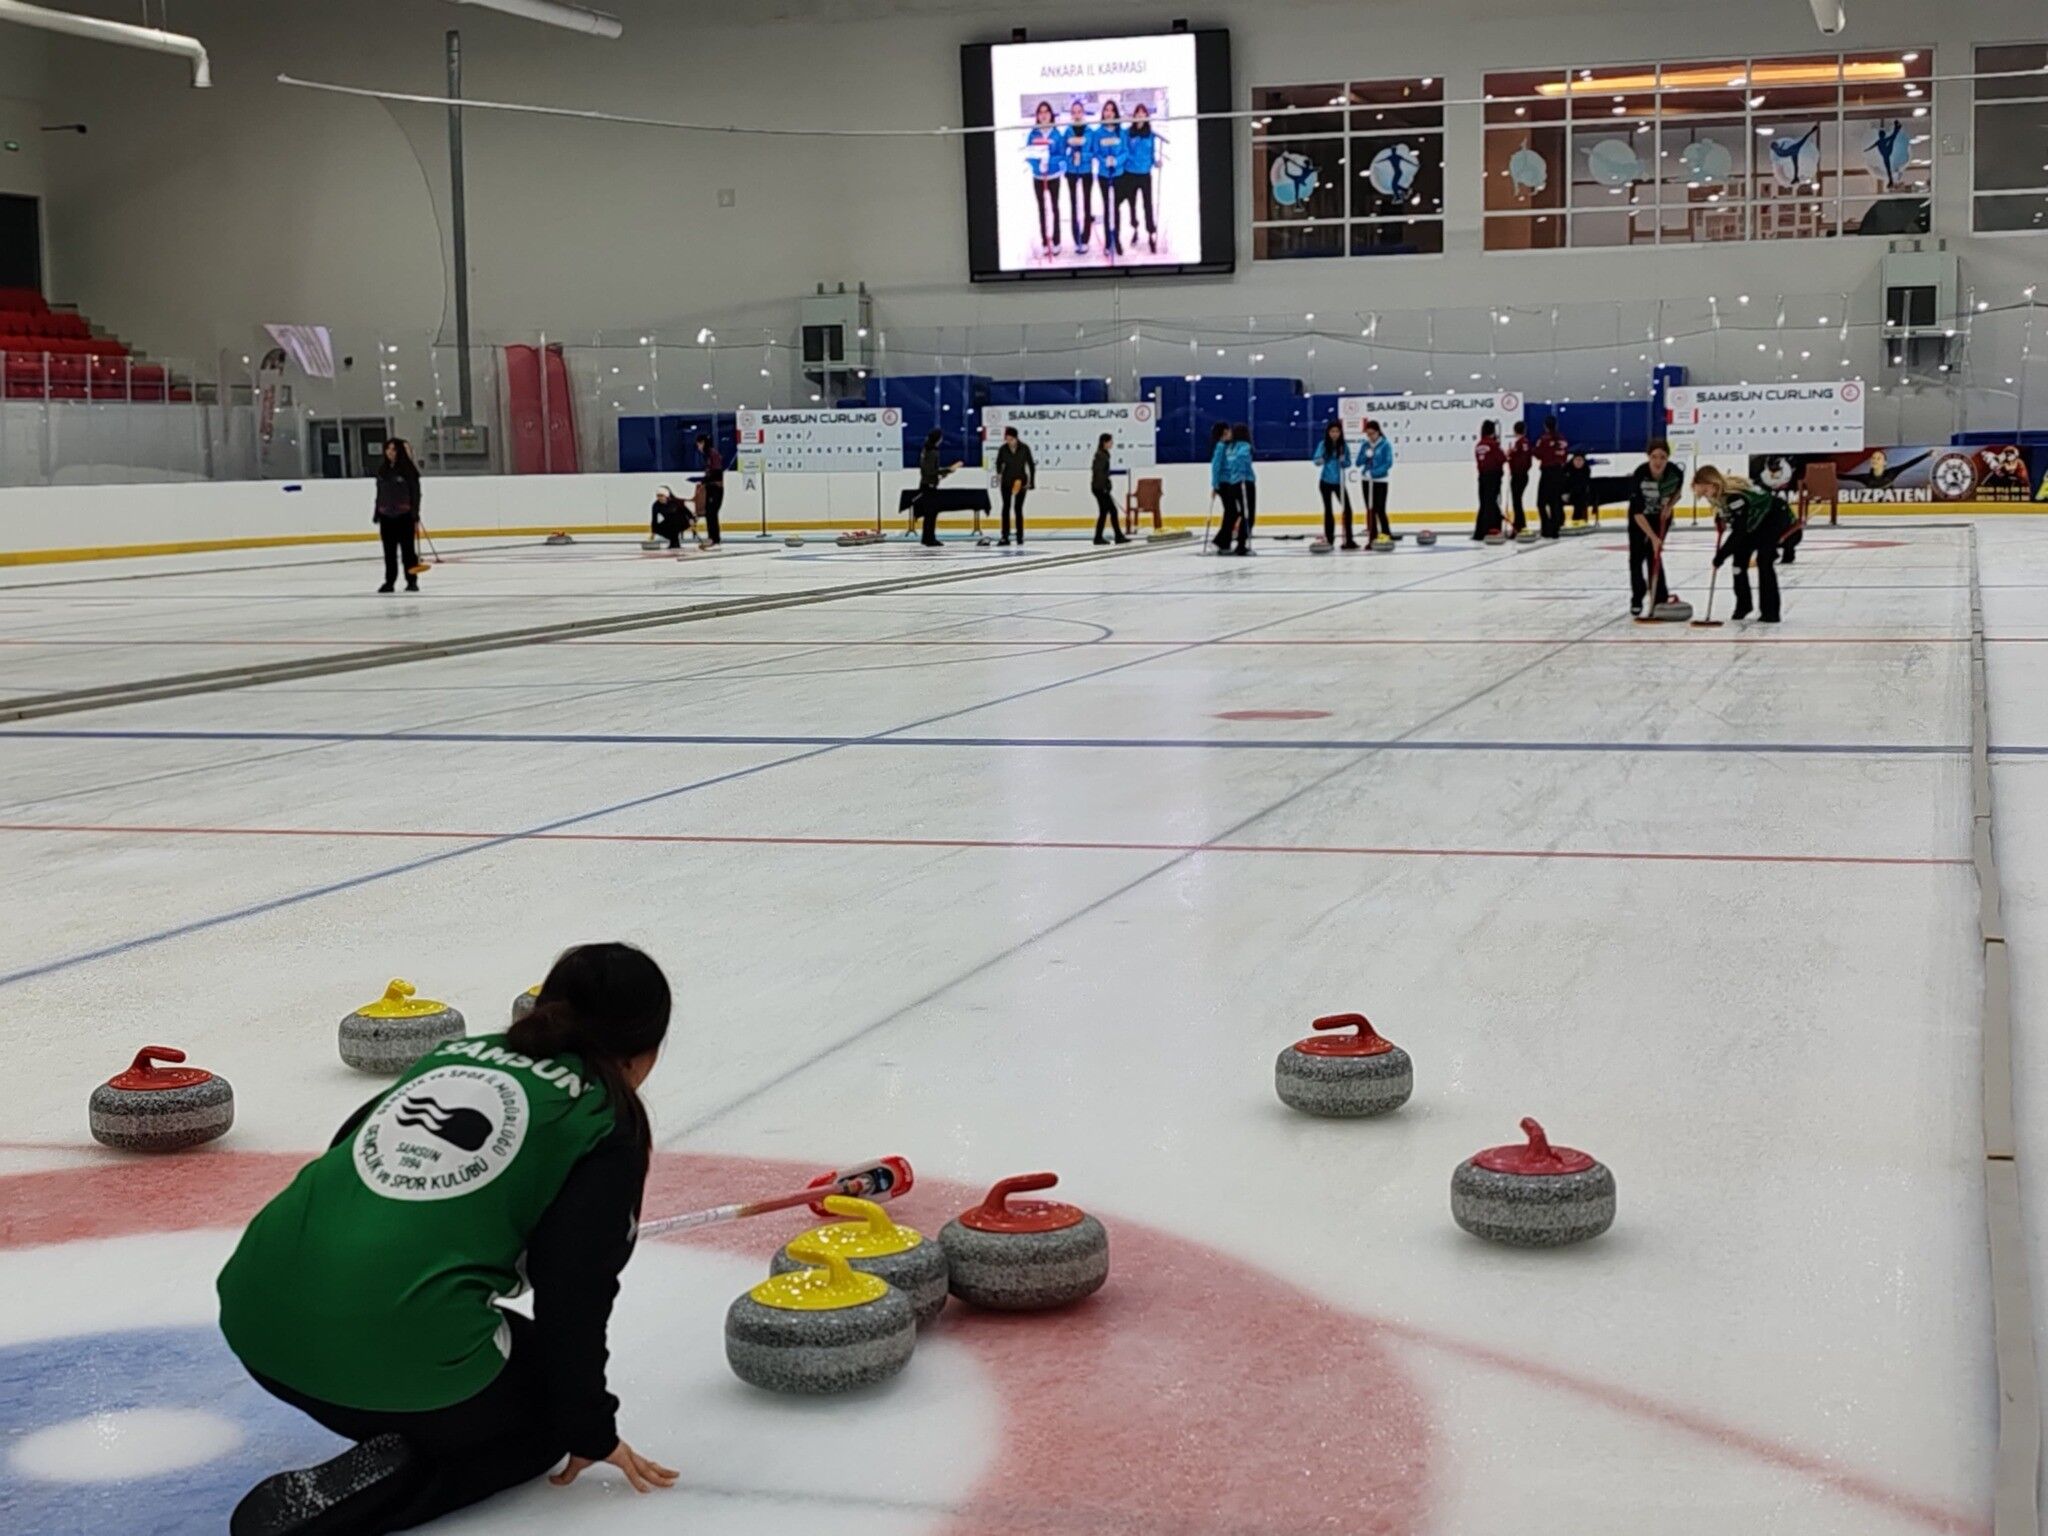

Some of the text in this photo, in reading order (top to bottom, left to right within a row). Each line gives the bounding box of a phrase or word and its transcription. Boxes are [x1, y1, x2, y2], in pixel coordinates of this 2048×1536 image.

[1041, 64, 1083, 77] ANKARA
[1696, 388, 1834, 402] SAMSUN CURLING
[1366, 398, 1495, 412] SAMSUN CURLING
[761, 413, 877, 424] SAMSUN CURLING
[1009, 409, 1128, 420] SAMSUN CURLING
[745, 478, 756, 491] A
[1838, 484, 1932, 503] BUZPATENİ
[359, 1123, 385, 1174] GENÇLİK
[390, 1174, 427, 1191] SPOR
[431, 1155, 489, 1190] KULÜBÜ
[395, 1141, 442, 1163] SAMSUN
[399, 1156, 422, 1170] 1994
